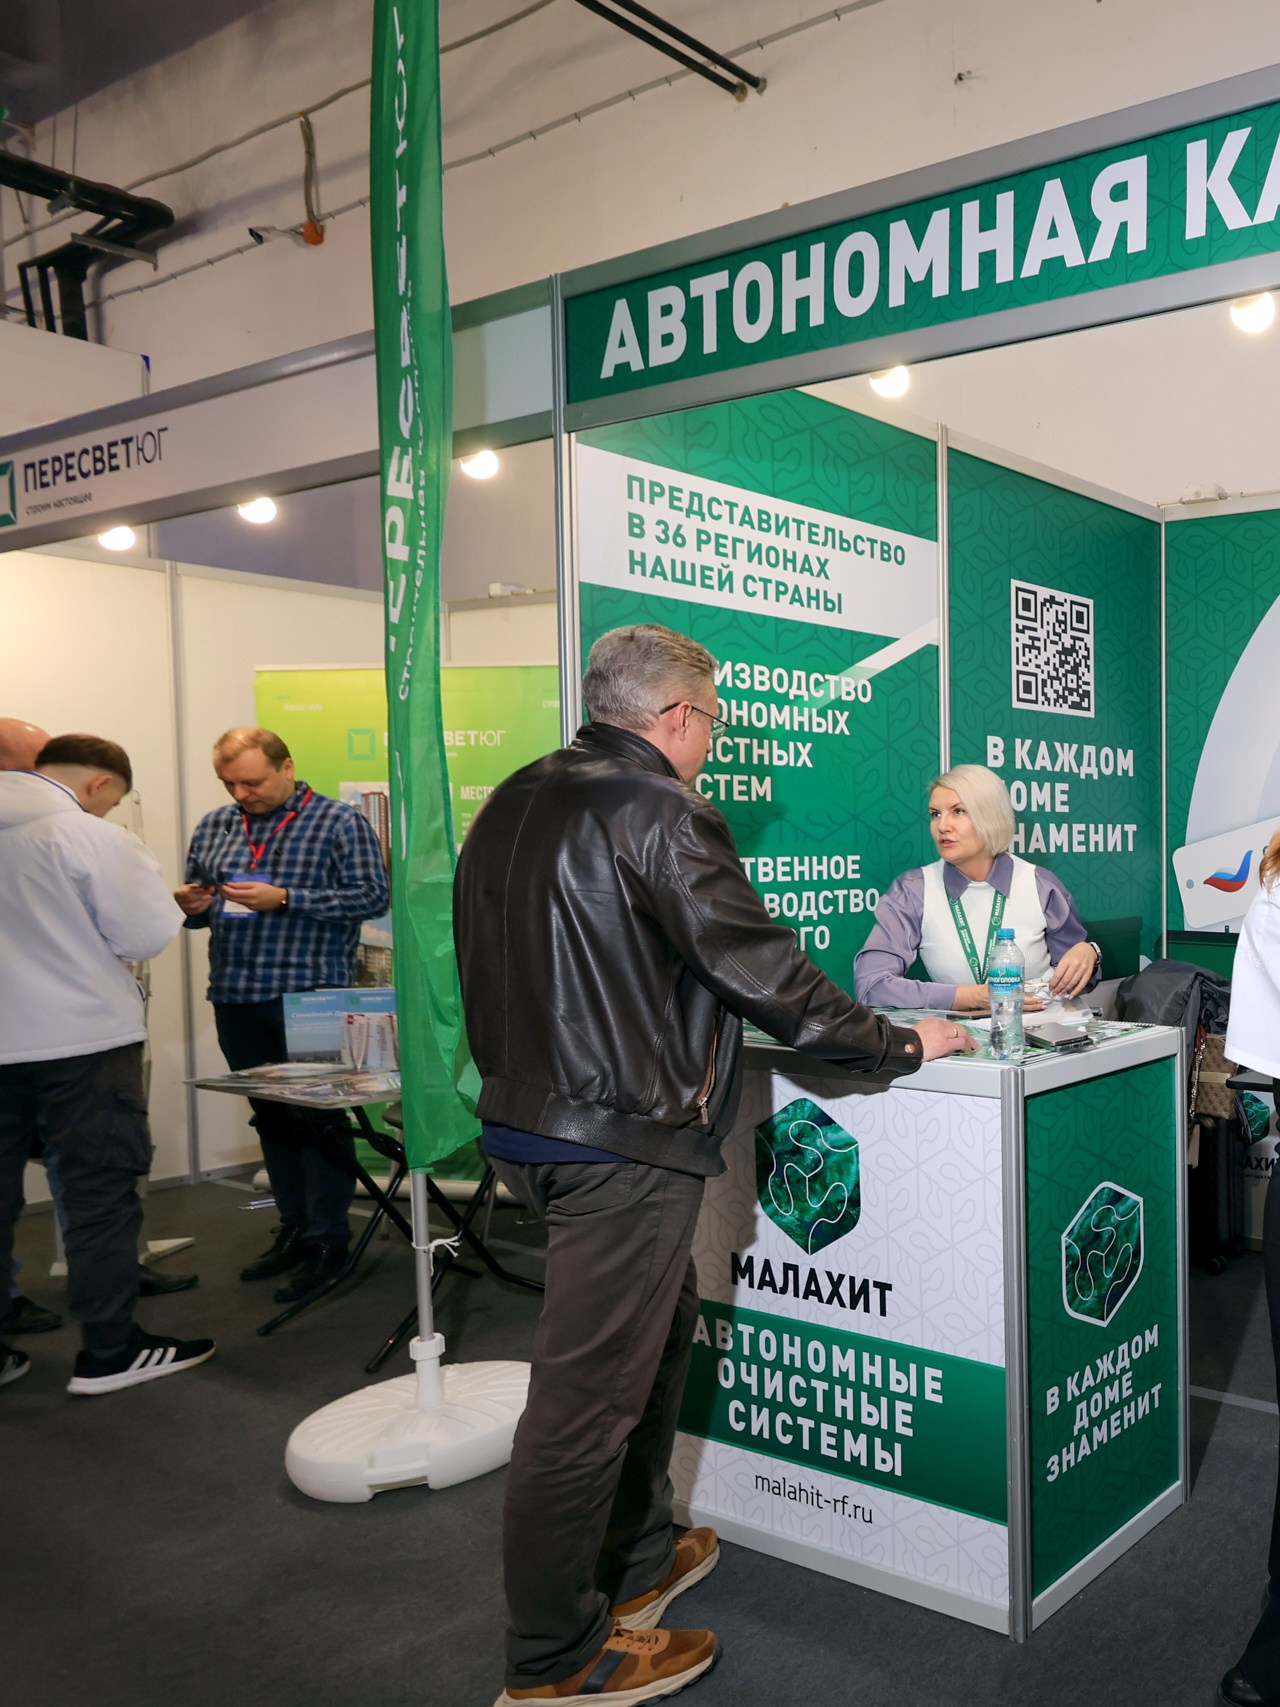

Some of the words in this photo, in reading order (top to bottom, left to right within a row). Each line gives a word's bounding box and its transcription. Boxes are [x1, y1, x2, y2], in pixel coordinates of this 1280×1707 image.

[600, 155, 1147, 379] АВТОНОМНАЯ
[23, 427, 168, 493] ПЕРЕСВЕТЮГ
[626, 473, 906, 567] ПРЕДСТАВИТЕЛЬСТВО
[628, 511, 646, 539] В
[655, 521, 688, 548] 36
[696, 529, 831, 581] РЕГИОНАХ
[628, 549, 734, 594] НАШЕЙ
[742, 574, 844, 615] СТРАНЫ
[714, 660, 872, 703] ИЗВОДСТВО
[716, 697, 850, 736] ОНОМНЫХ
[707, 736, 814, 768] СТНЫХ
[987, 735, 1005, 768] В
[1014, 738, 1134, 780] КАЖДОМ
[695, 773, 772, 802] СТЕМ
[1008, 780, 1070, 813] ОМЕ
[739, 855, 861, 883] ТВЕННОЕ
[1008, 823, 1137, 854] НАМЕНИТ
[764, 888, 880, 922] ВОДСТВО
[730, 1251, 893, 1318] МАЛАХИТ
[691, 1313, 944, 1405] АВТОНОМНЫЕ
[1046, 1384, 1060, 1418] В
[1066, 1322, 1160, 1408] КАЖДОМ
[717, 1360, 914, 1438] ОЧИСТНЫЕ
[1073, 1372, 1134, 1434] ДОМЕ
[728, 1401, 902, 1477] СИСТЕМЫ
[1046, 1382, 1163, 1485] ЗНАМЕНИТ
[754, 1472, 874, 1526] malahit-rf.ru
